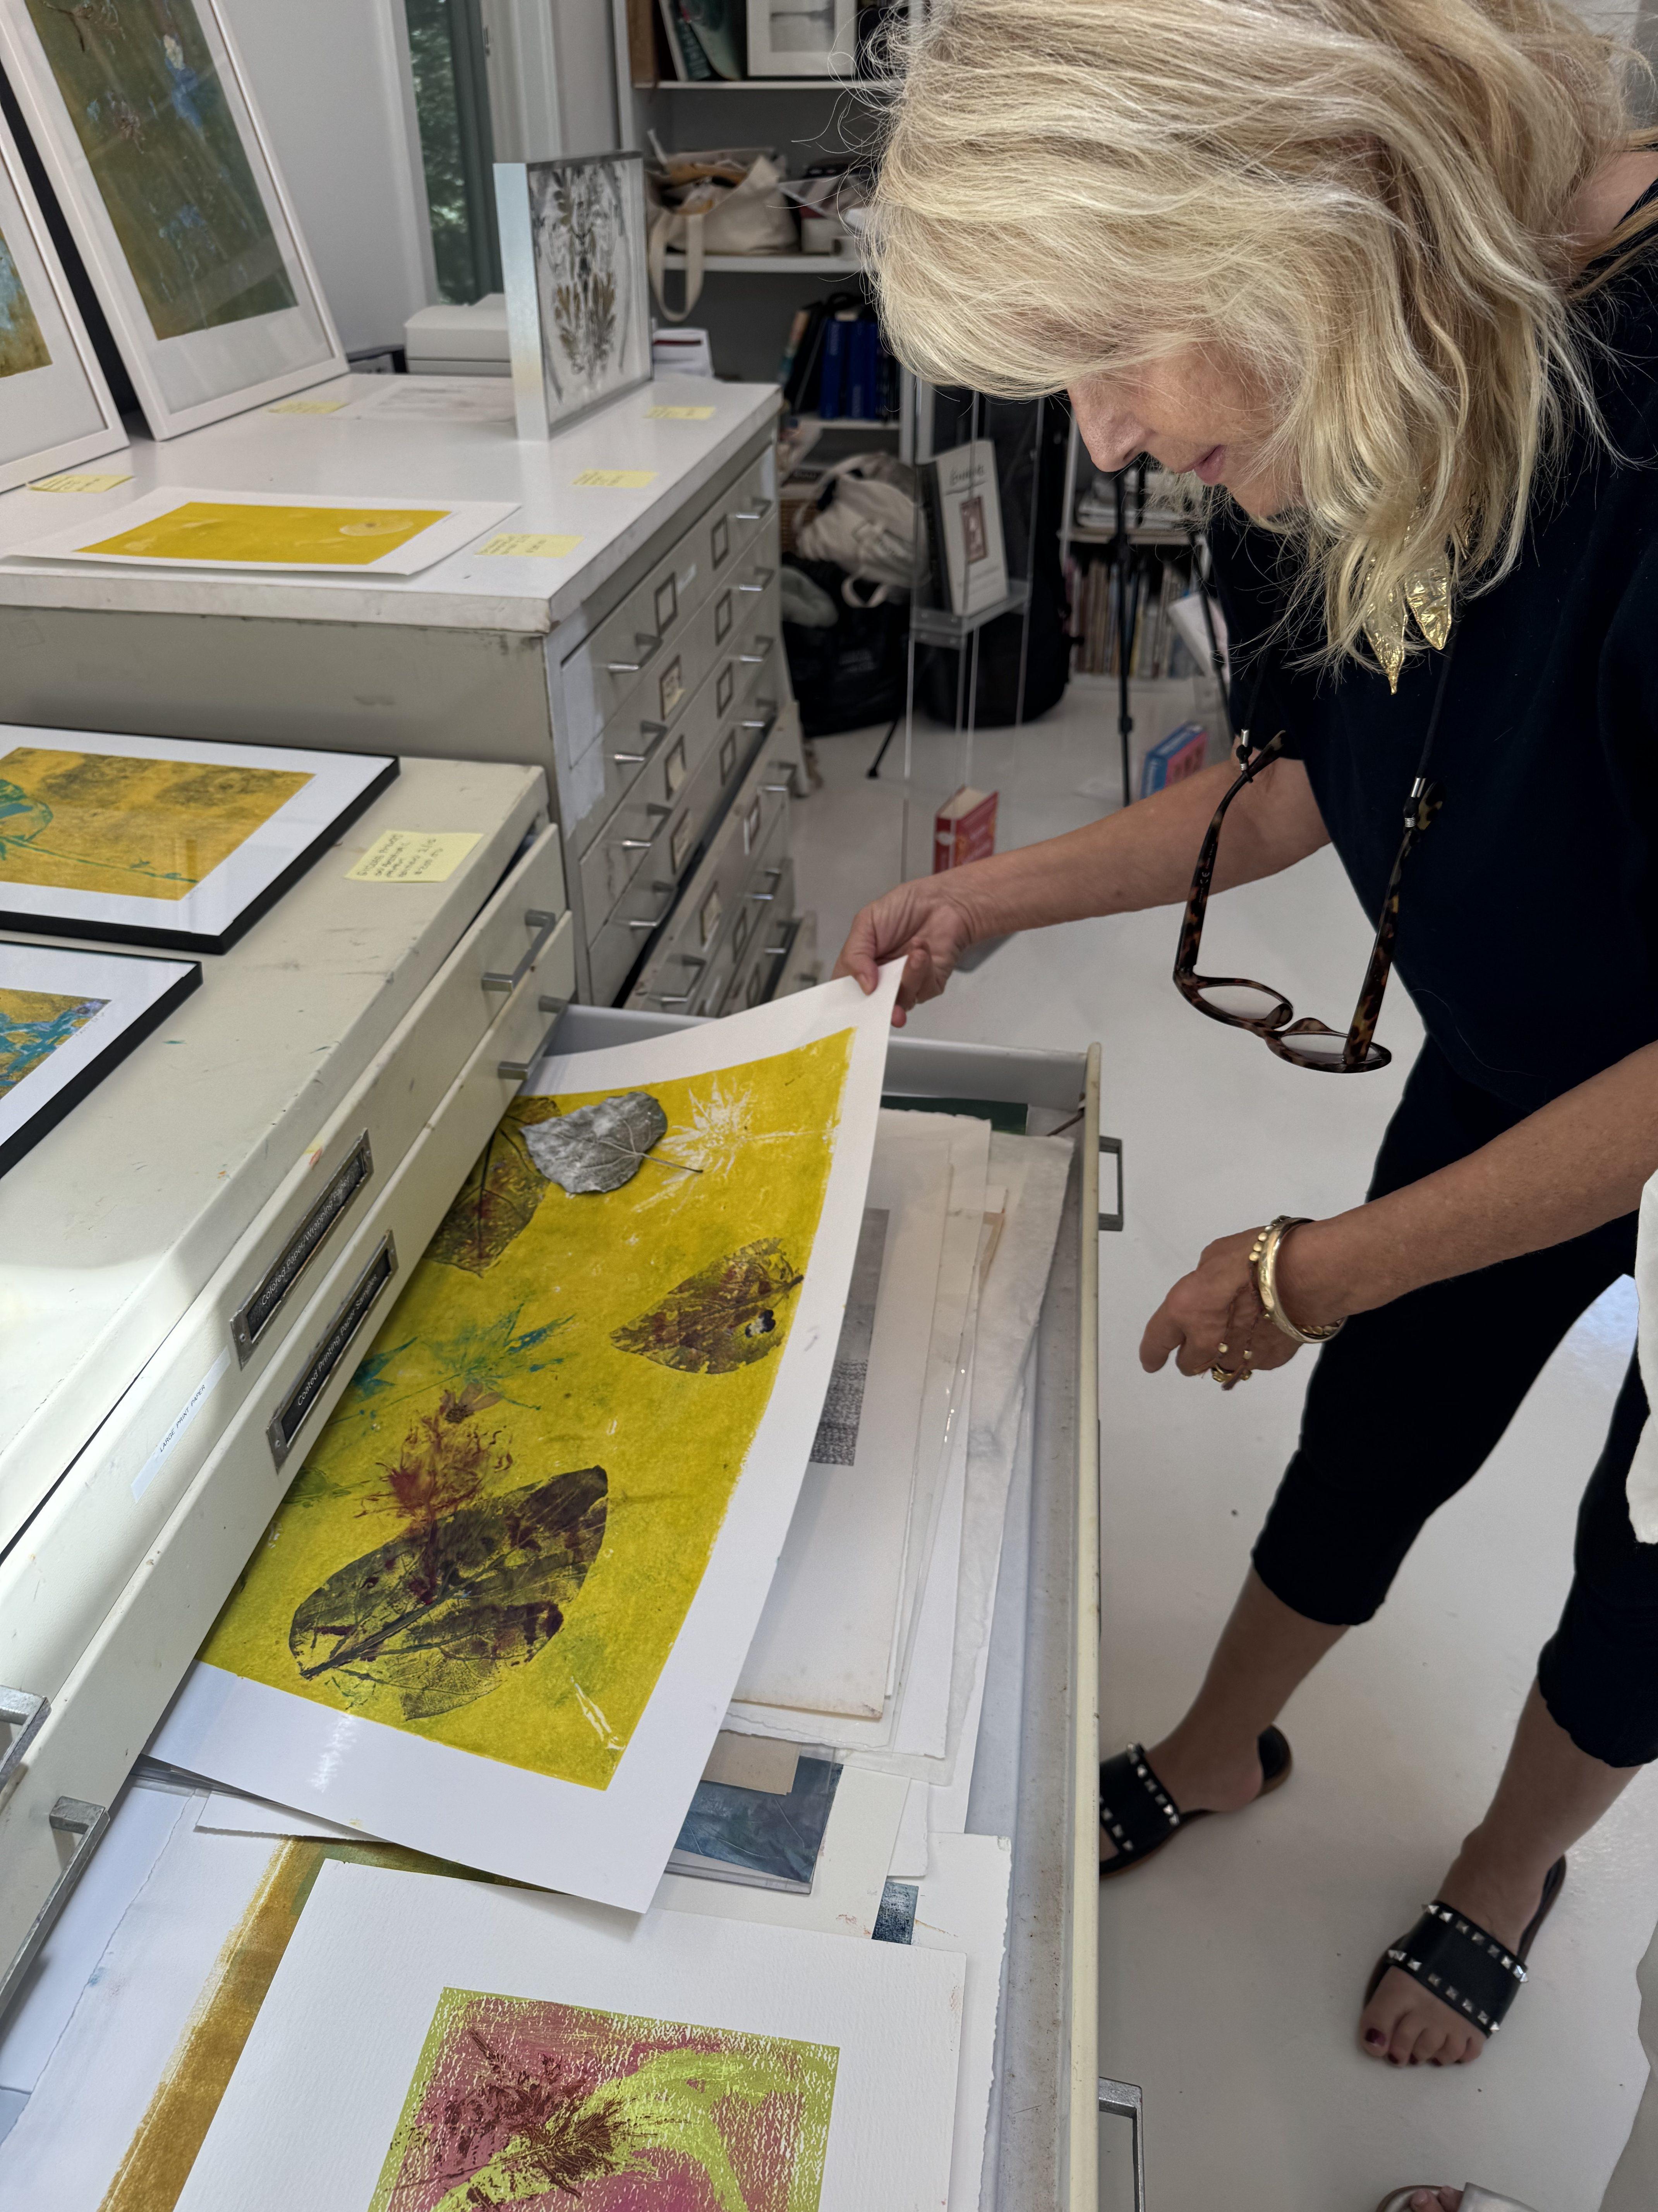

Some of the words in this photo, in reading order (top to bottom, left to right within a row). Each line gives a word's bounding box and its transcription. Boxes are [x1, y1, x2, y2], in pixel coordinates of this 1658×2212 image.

[262, 1266, 285, 1305] Colored
[287, 1200, 333, 1270] Paper/Wrapping
[332, 1176, 349, 1201] Paper
[298, 1369, 318, 1405] Coated
[318, 1336, 340, 1372] Printing
[341, 1310, 355, 1336] Paper
[355, 1274, 377, 1310] Samples
[160, 1428, 175, 1453] LARGE
[176, 1407, 189, 1428] PRINT
[191, 1384, 205, 1407] PAPER
